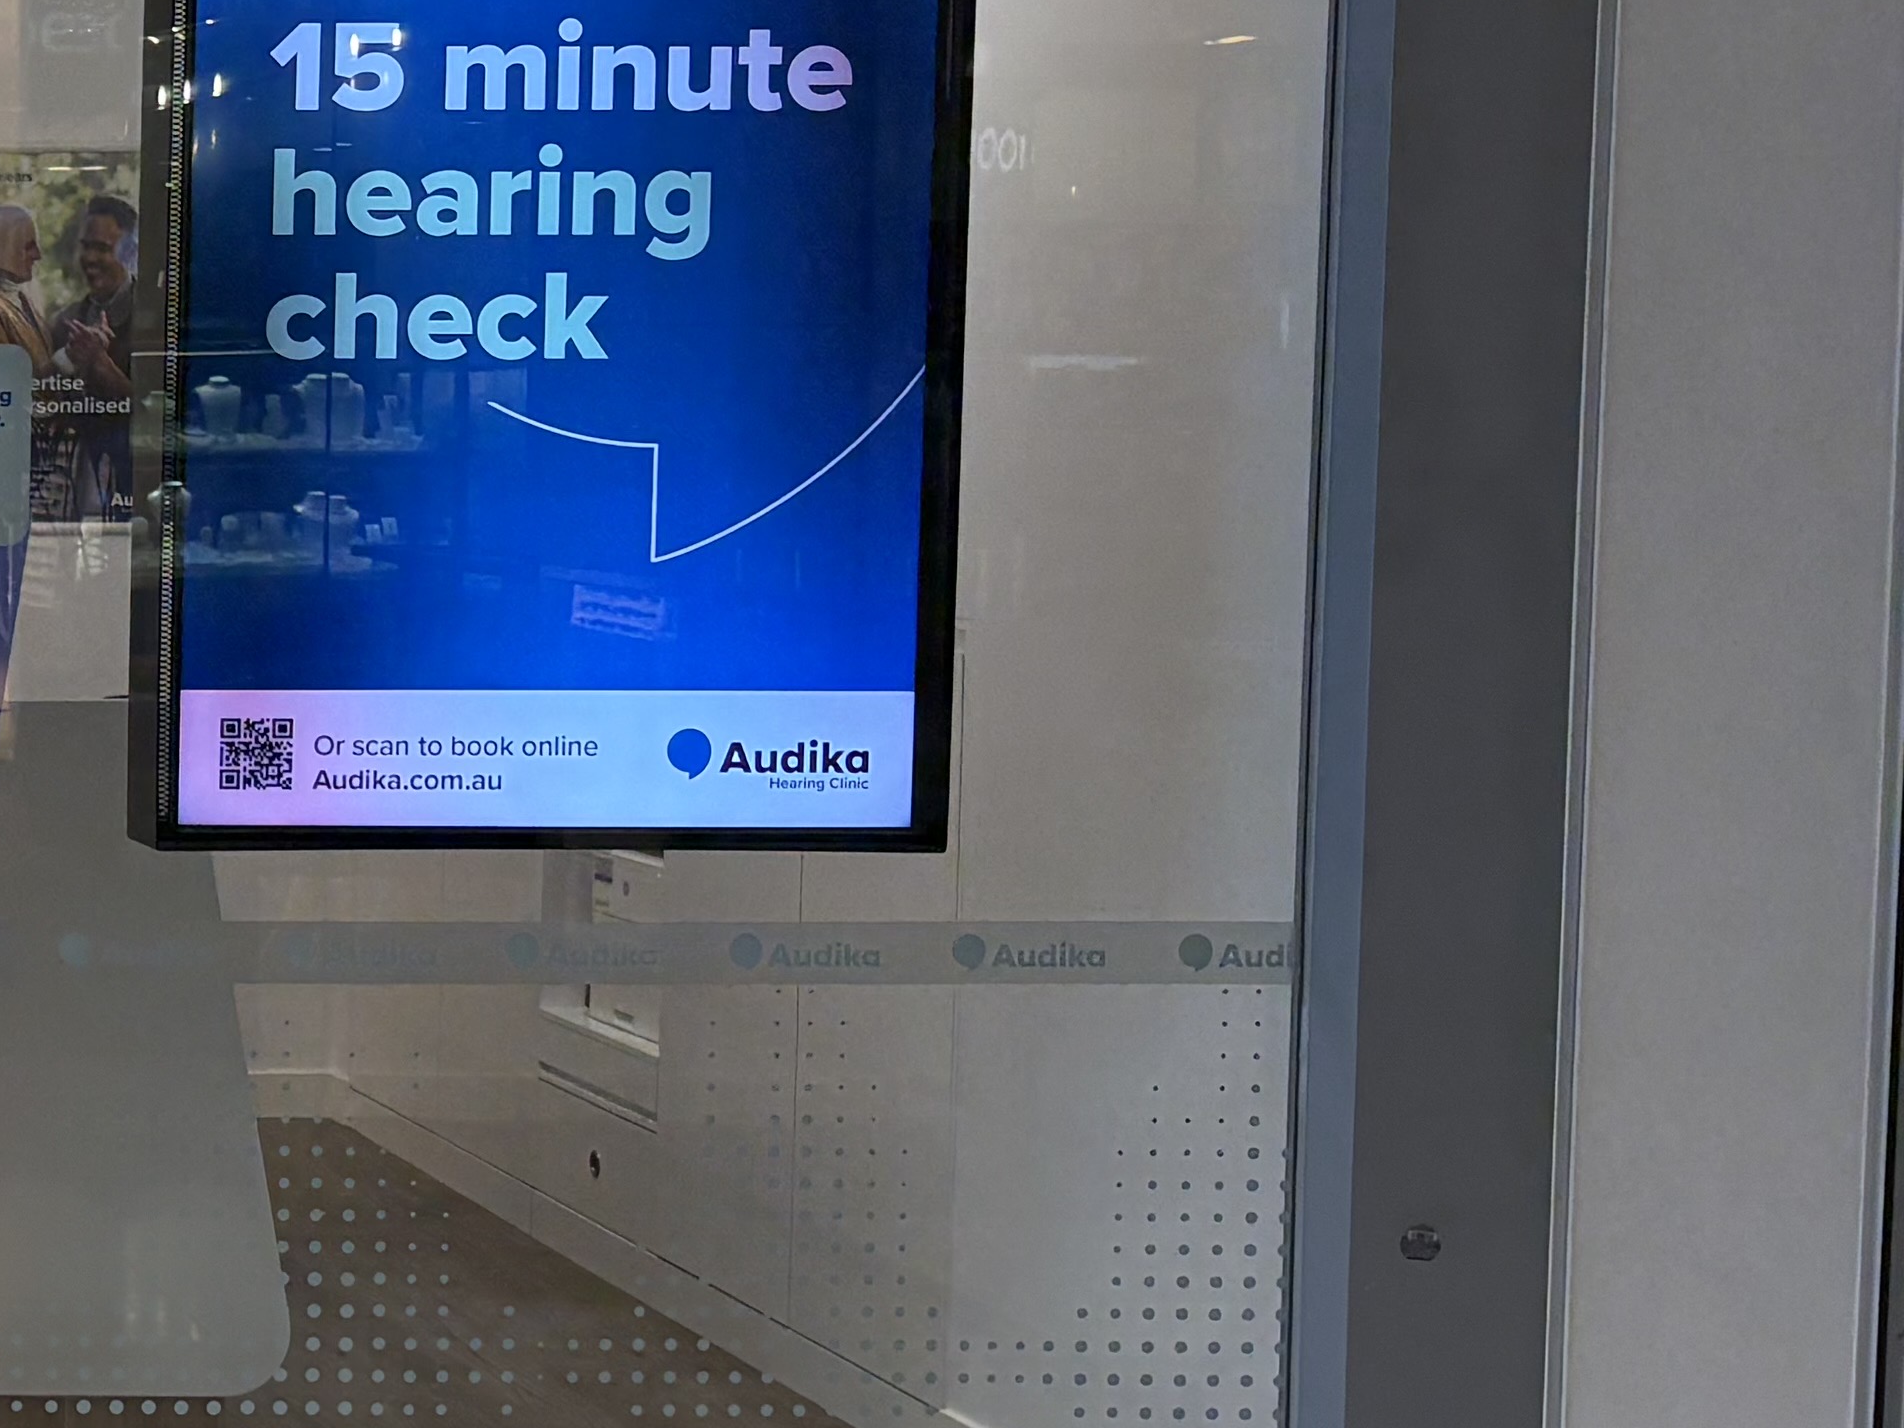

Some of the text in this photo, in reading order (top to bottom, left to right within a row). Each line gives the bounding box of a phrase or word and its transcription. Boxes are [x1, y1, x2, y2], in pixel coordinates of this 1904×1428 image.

[269, 18, 853, 112] 15 minute
[271, 143, 713, 261] hearing
[264, 272, 610, 361] check
[314, 733, 599, 757] Or scan to book online
[719, 738, 871, 775] Audika
[312, 767, 503, 792] Audika.com.au
[769, 775, 871, 793] Hearing Clinic
[767, 941, 881, 969] Audika
[993, 941, 1106, 970] Audika
